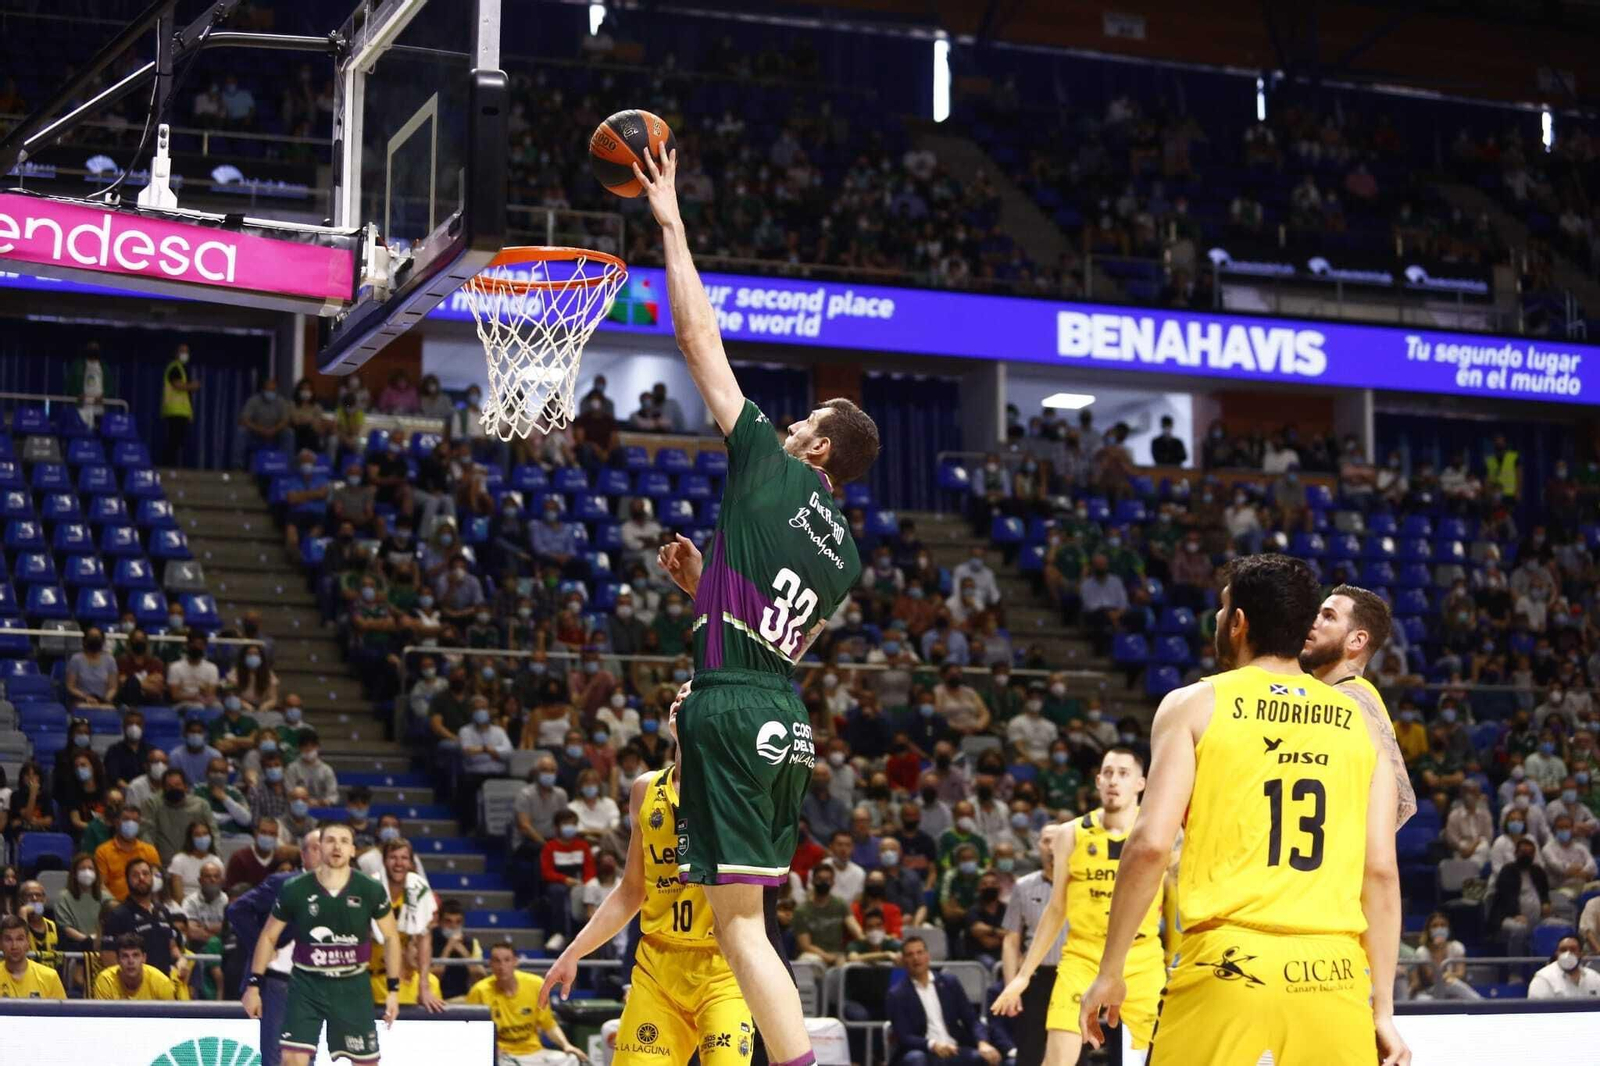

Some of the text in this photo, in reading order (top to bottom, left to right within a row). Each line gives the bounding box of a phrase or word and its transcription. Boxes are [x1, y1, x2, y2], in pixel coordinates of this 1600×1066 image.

[736, 287, 825, 312] second
[827, 289, 894, 319] place
[748, 312, 821, 337] world
[1057, 311, 1327, 376] BENAHAVIS
[1405, 334, 1581, 375] Tu segundo lugar
[1455, 365, 1581, 395] en el mundo
[759, 567, 818, 656] 32
[1233, 697, 1352, 730] S. RODRÍGUEZ
[792, 721, 813, 740] COST
[793, 738, 809, 752] DEL
[788, 751, 815, 769] MÁLAG
[1264, 778, 1326, 872] 13
[656, 875, 681, 888] ten
[1086, 868, 1116, 881] Len
[672, 900, 693, 932] 10
[1283, 958, 1354, 983] CICAR
[1285, 984, 1318, 993] Canary
[620, 1043, 630, 1052] LA
[632, 1043, 671, 1057] LAGUNA
